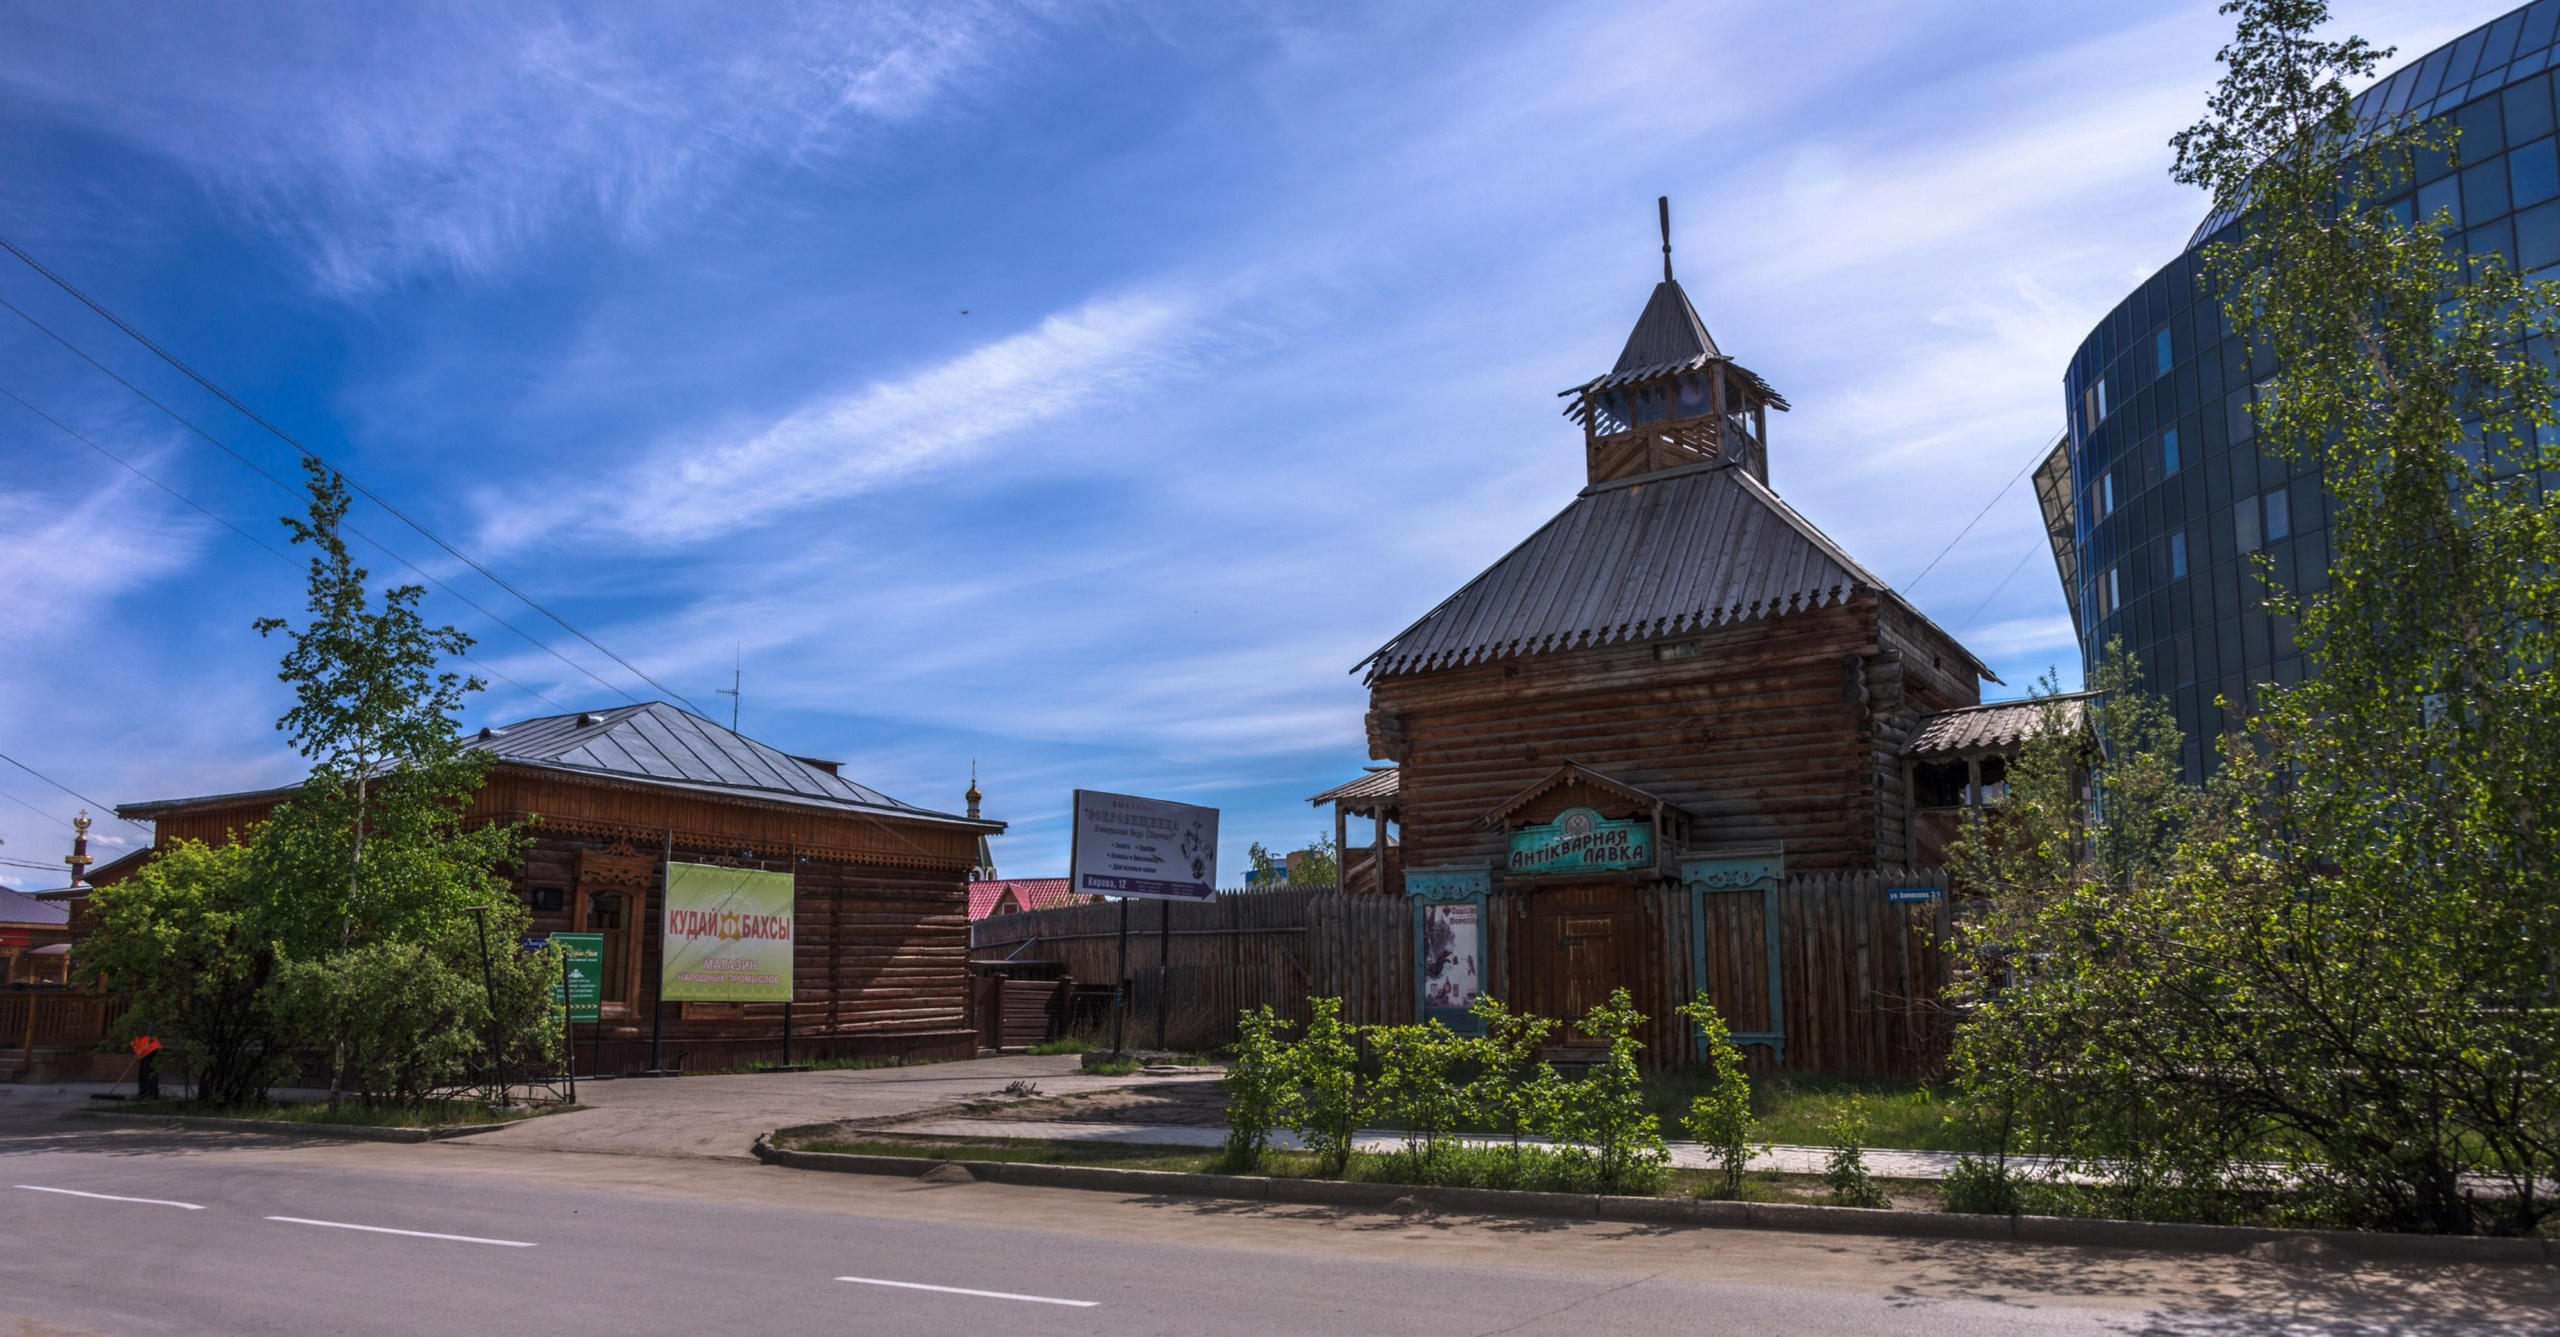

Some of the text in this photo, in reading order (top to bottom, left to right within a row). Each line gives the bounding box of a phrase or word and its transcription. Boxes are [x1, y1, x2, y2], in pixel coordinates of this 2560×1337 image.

[1583, 845, 1644, 863] ЛАВКА
[1087, 876, 1117, 890] Кирова,
[1118, 879, 1127, 889] 12
[669, 907, 790, 940] КУДАЙ БАХСЫ
[703, 958, 757, 971] МАГАЗИН
[677, 972, 781, 985] НАРОДНЫХ ПРОМЫСЛОВ
